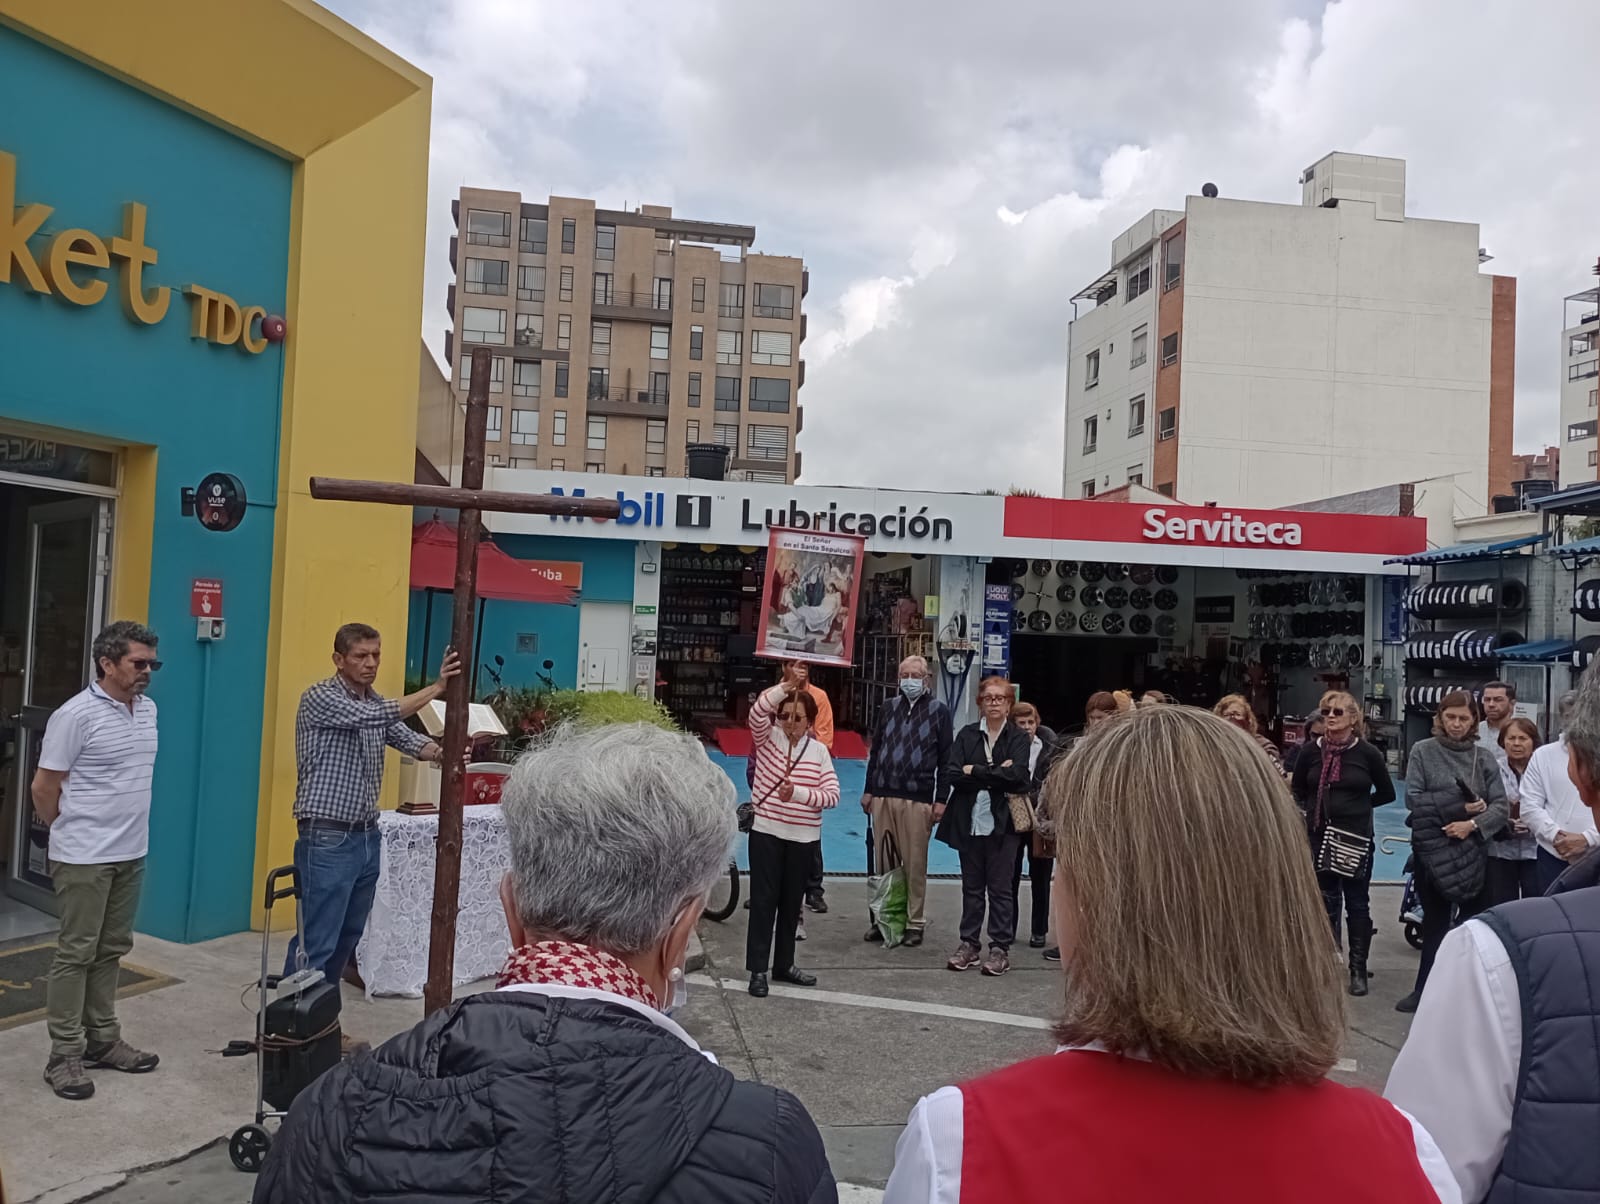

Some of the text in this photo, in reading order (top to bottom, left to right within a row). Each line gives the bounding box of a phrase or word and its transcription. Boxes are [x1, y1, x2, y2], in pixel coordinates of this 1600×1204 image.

[741, 498, 953, 540] Lubricación
[1142, 508, 1302, 545] Serviteca
[793, 541, 800, 549] el
[800, 543, 820, 551] Santo
[820, 545, 851, 555] Sepulcro
[804, 535, 831, 545] El Señor
